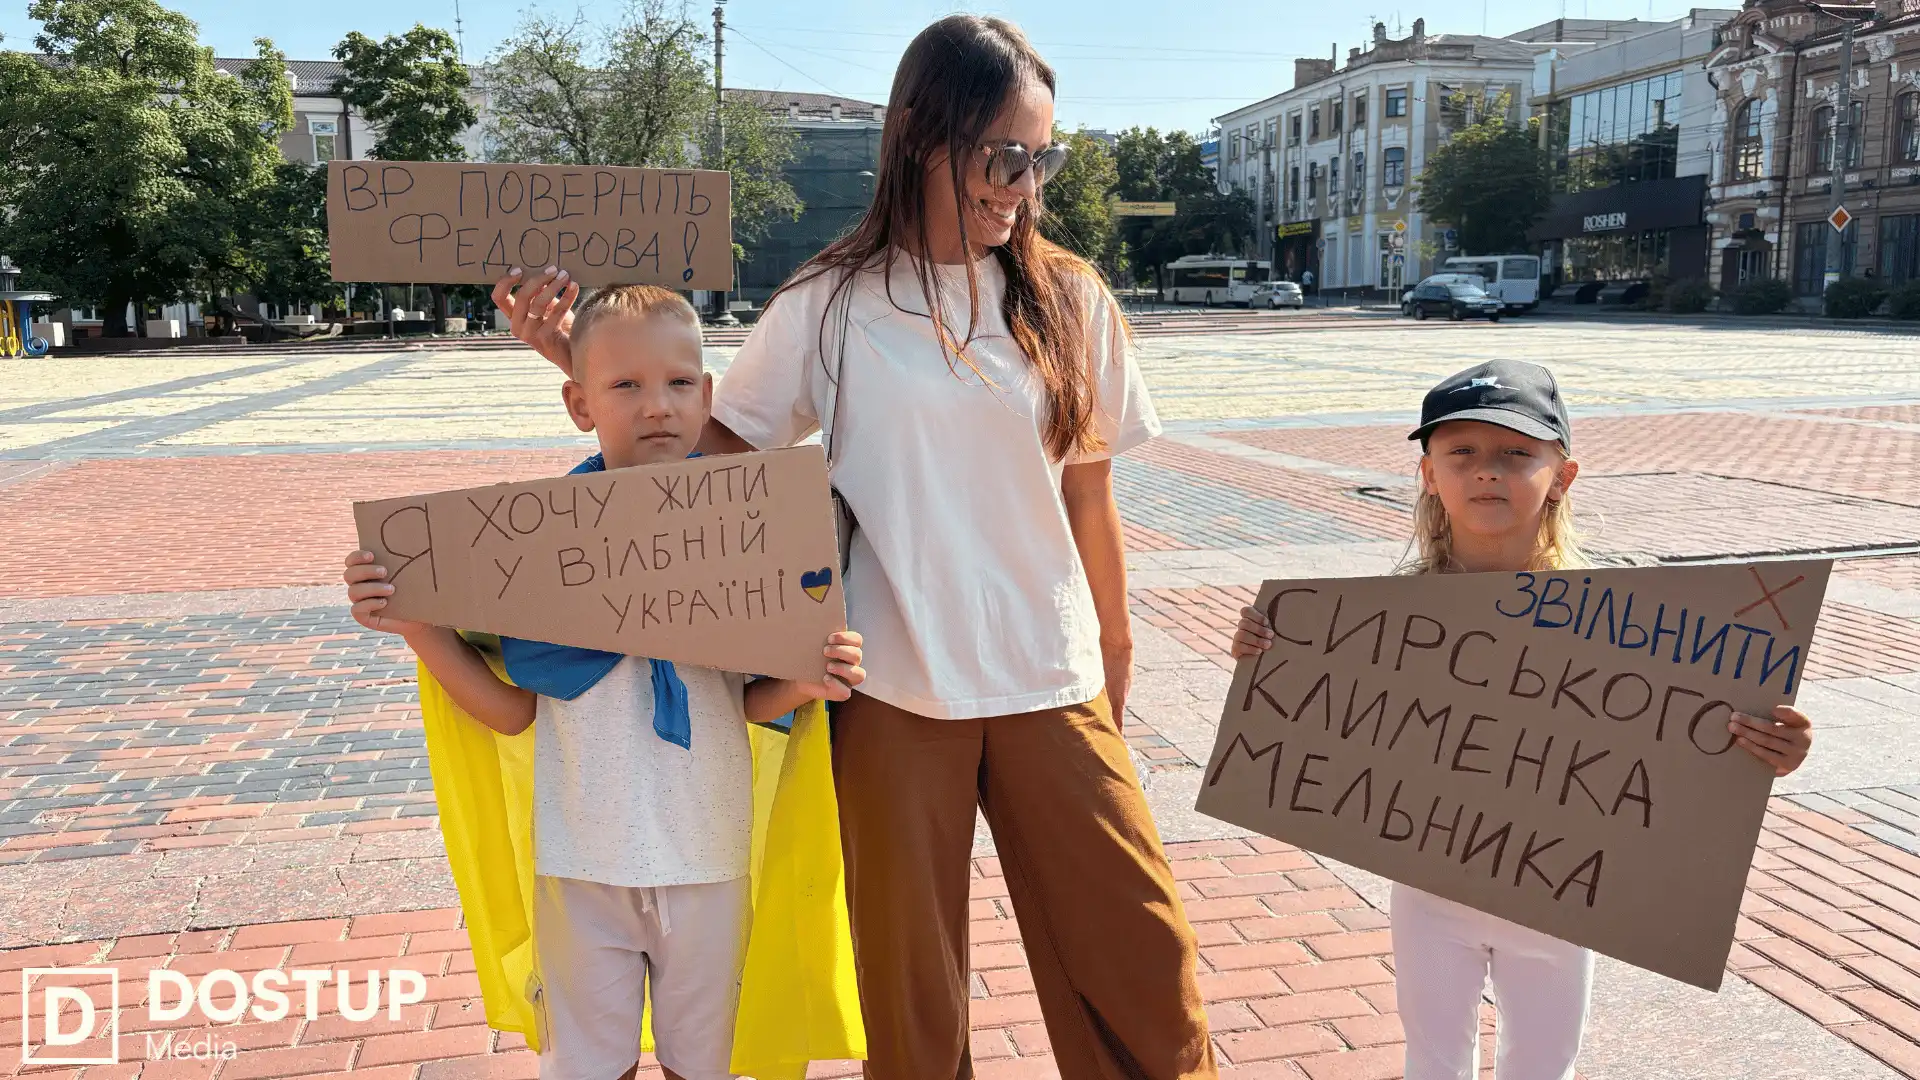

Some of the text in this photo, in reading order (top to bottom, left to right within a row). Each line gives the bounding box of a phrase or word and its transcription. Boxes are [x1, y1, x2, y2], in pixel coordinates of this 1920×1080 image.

[343, 166, 711, 222] ВР ПОВЕРНІТЬ
[1583, 212, 1627, 231] ROSHEN
[381, 463, 769, 593] Я ХОЧУ ЖИТИ
[494, 556, 523, 599] У
[602, 569, 786, 633] УКРАЇНІ
[1496, 572, 1800, 695] ЗВІЛЬНИТИ
[1267, 588, 1738, 756] СИРСЬКОГО
[1242, 654, 1654, 828] КЛИМЕНКА
[1209, 733, 1604, 908] МЕЛЬНИКА
